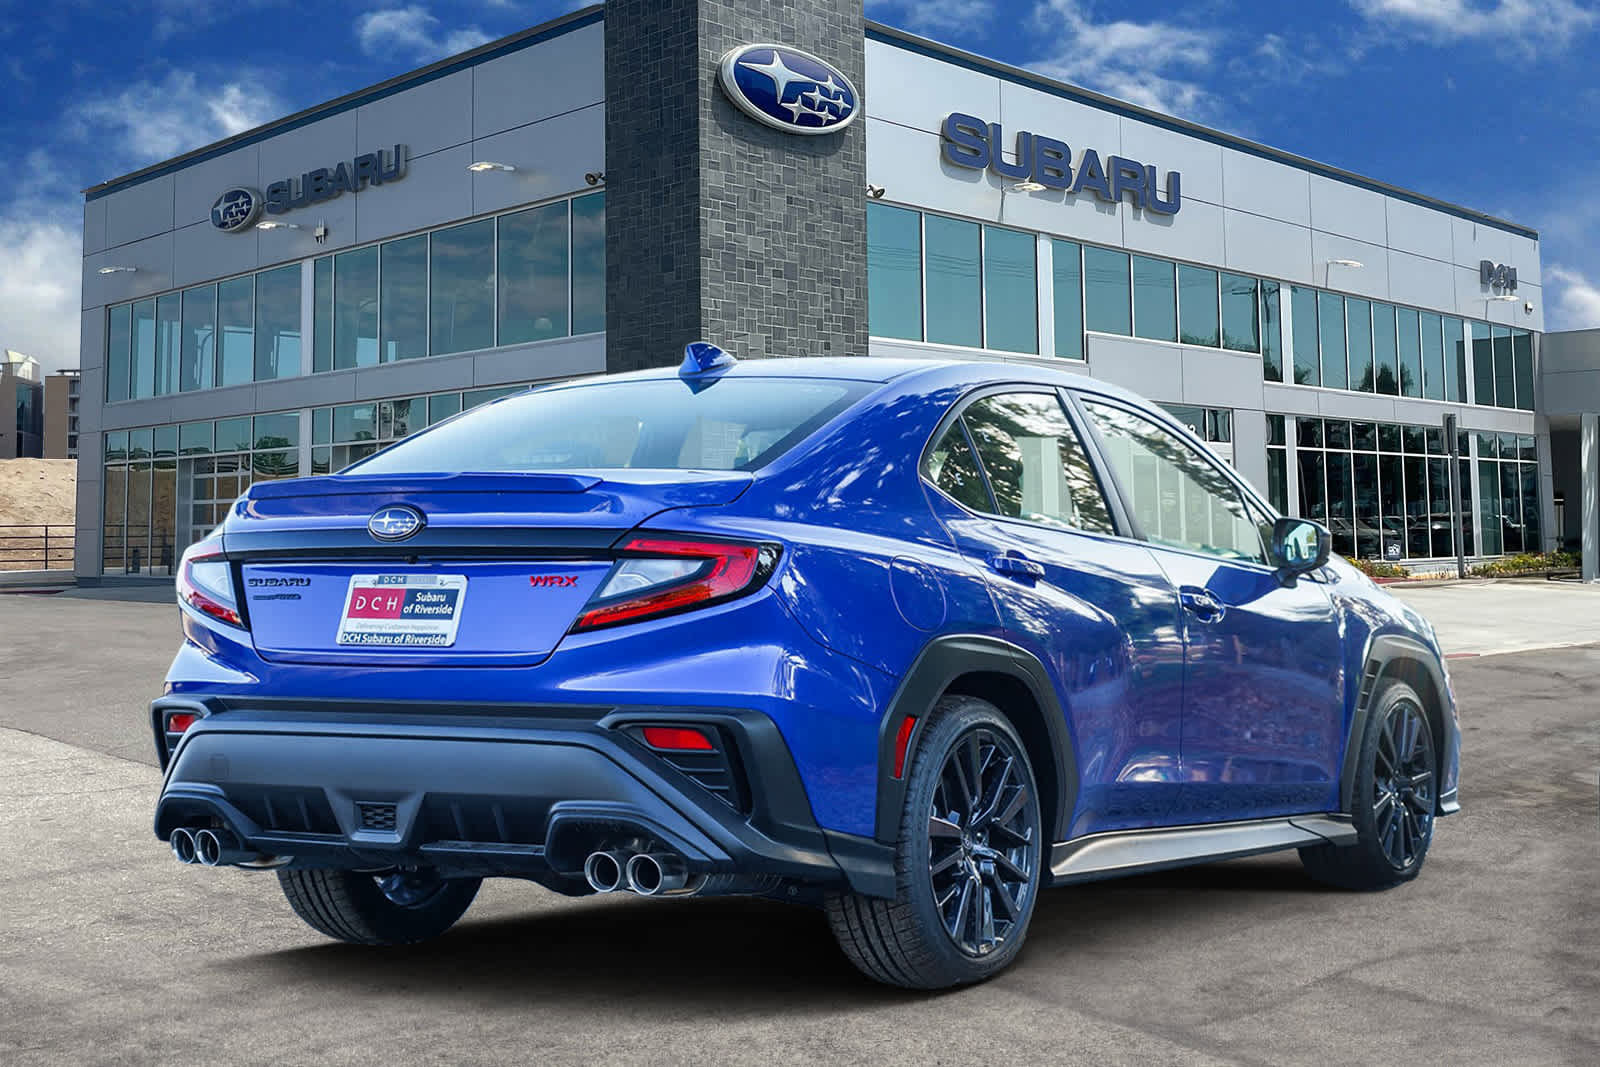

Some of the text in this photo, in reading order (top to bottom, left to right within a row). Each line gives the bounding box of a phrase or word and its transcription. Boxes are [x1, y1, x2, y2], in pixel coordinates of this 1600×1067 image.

[941, 112, 1181, 216] SUBARU
[265, 143, 407, 215] SUBARU
[248, 577, 311, 587] SUBARU
[530, 575, 579, 587] WRX
[415, 592, 447, 603] Subaru
[403, 604, 454, 615] of Riverside
[343, 632, 447, 645] DCH Subaru of Riverside
